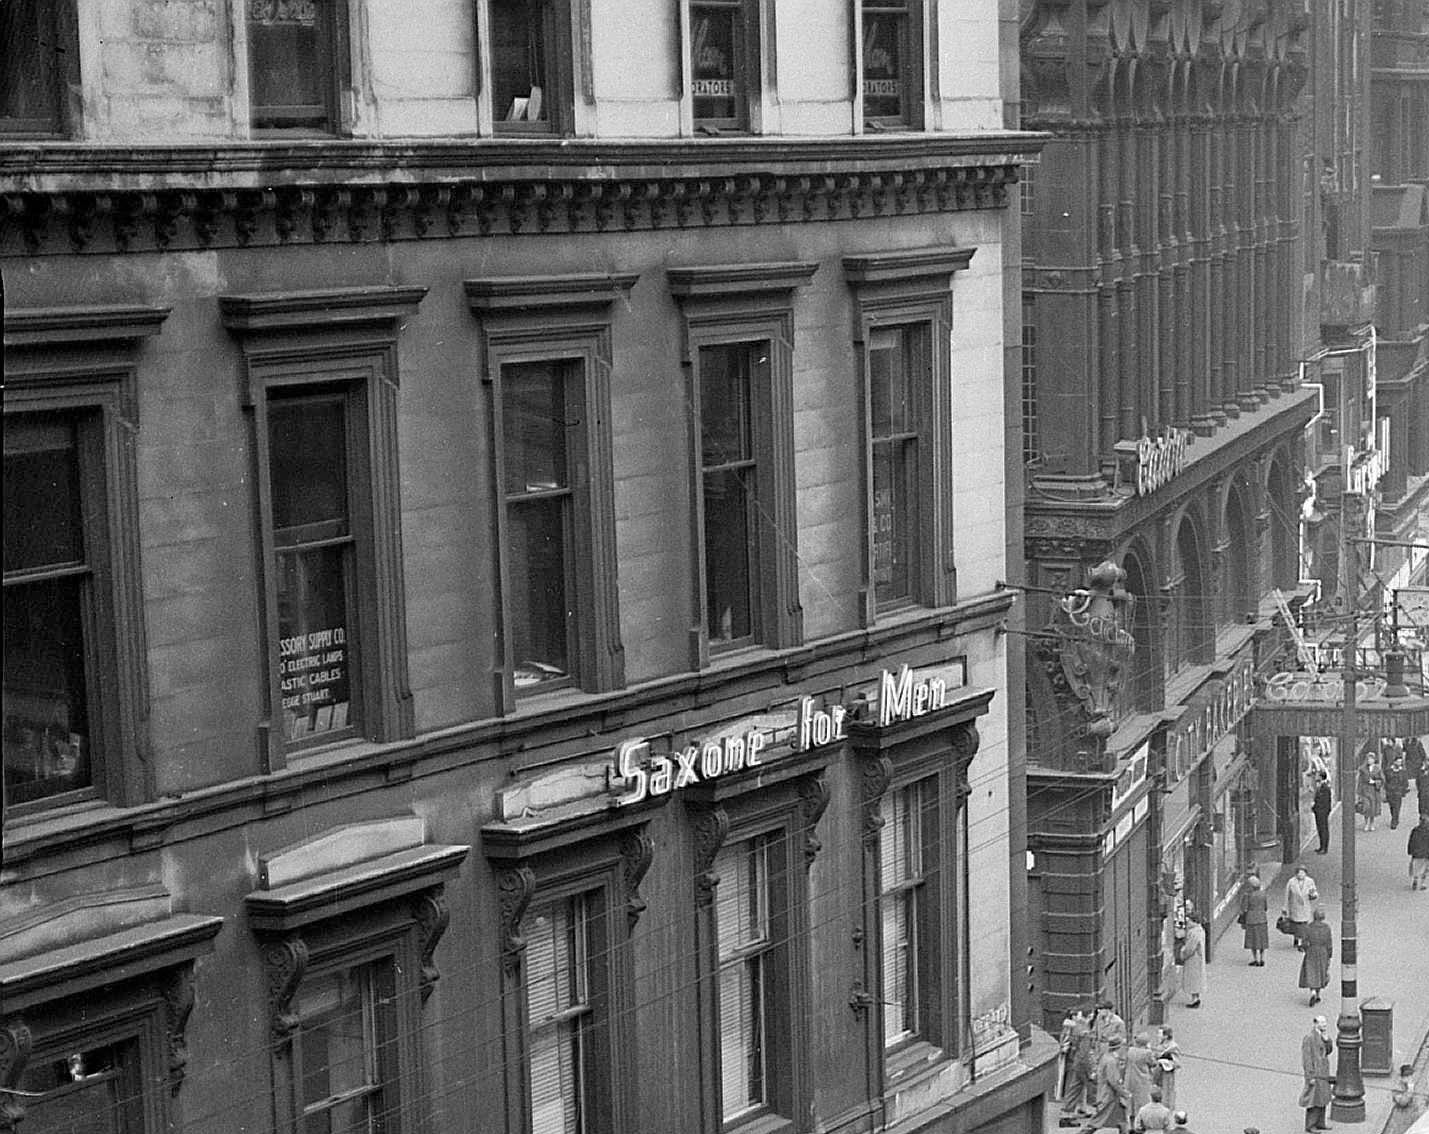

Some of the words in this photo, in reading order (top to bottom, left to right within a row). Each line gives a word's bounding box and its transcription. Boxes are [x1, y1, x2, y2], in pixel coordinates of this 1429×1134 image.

[309, 668, 341, 685] CABLES
[617, 727, 764, 806] Saxone
[800, 695, 847, 751] for
[880, 664, 949, 727] Men
